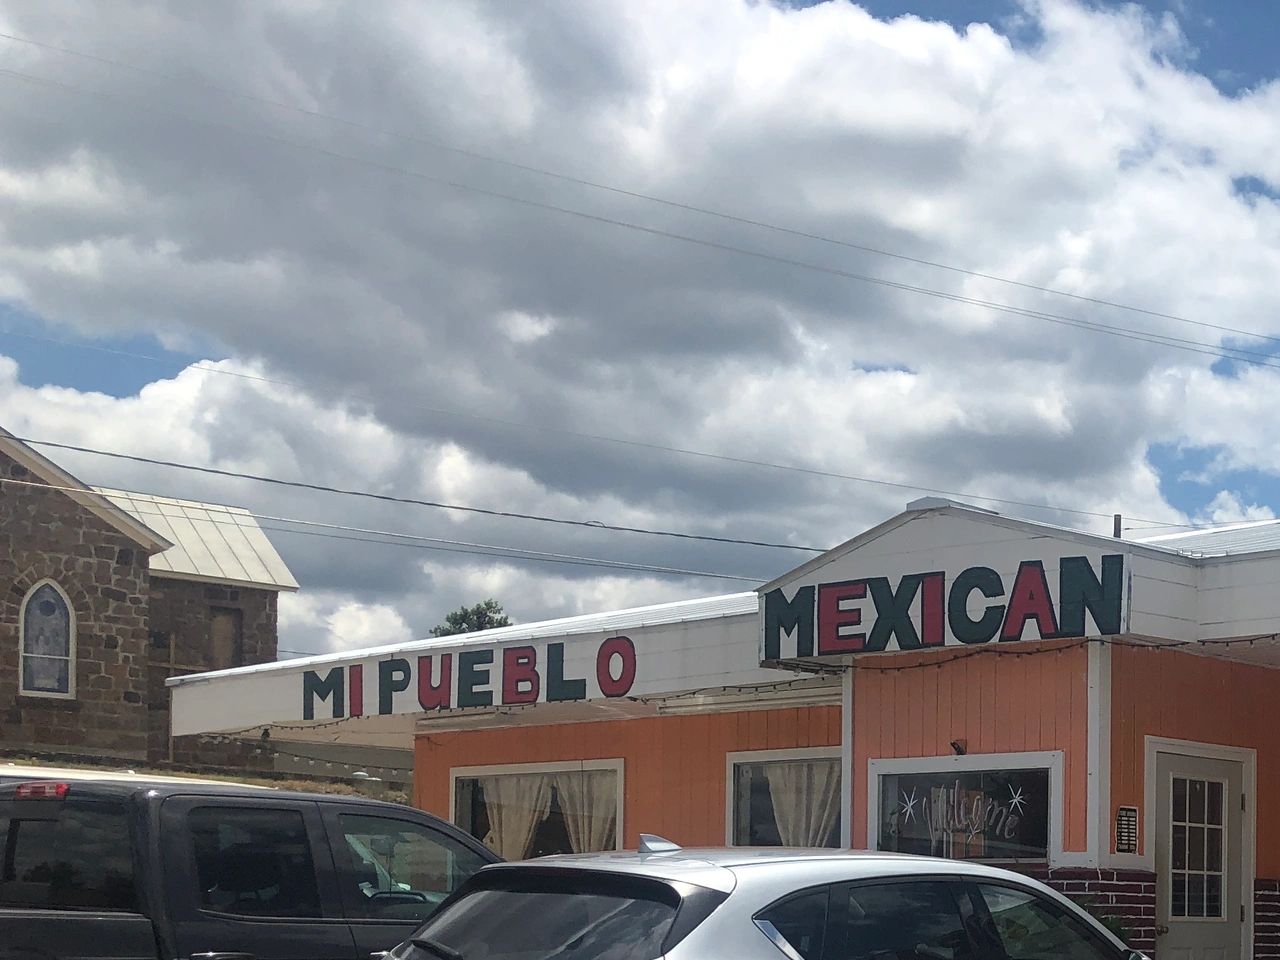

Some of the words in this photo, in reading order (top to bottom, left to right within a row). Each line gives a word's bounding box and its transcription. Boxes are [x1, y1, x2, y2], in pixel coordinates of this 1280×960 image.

[764, 554, 1125, 661] MEXICAN
[302, 664, 363, 720] MI
[378, 636, 637, 715] PUEBLO
